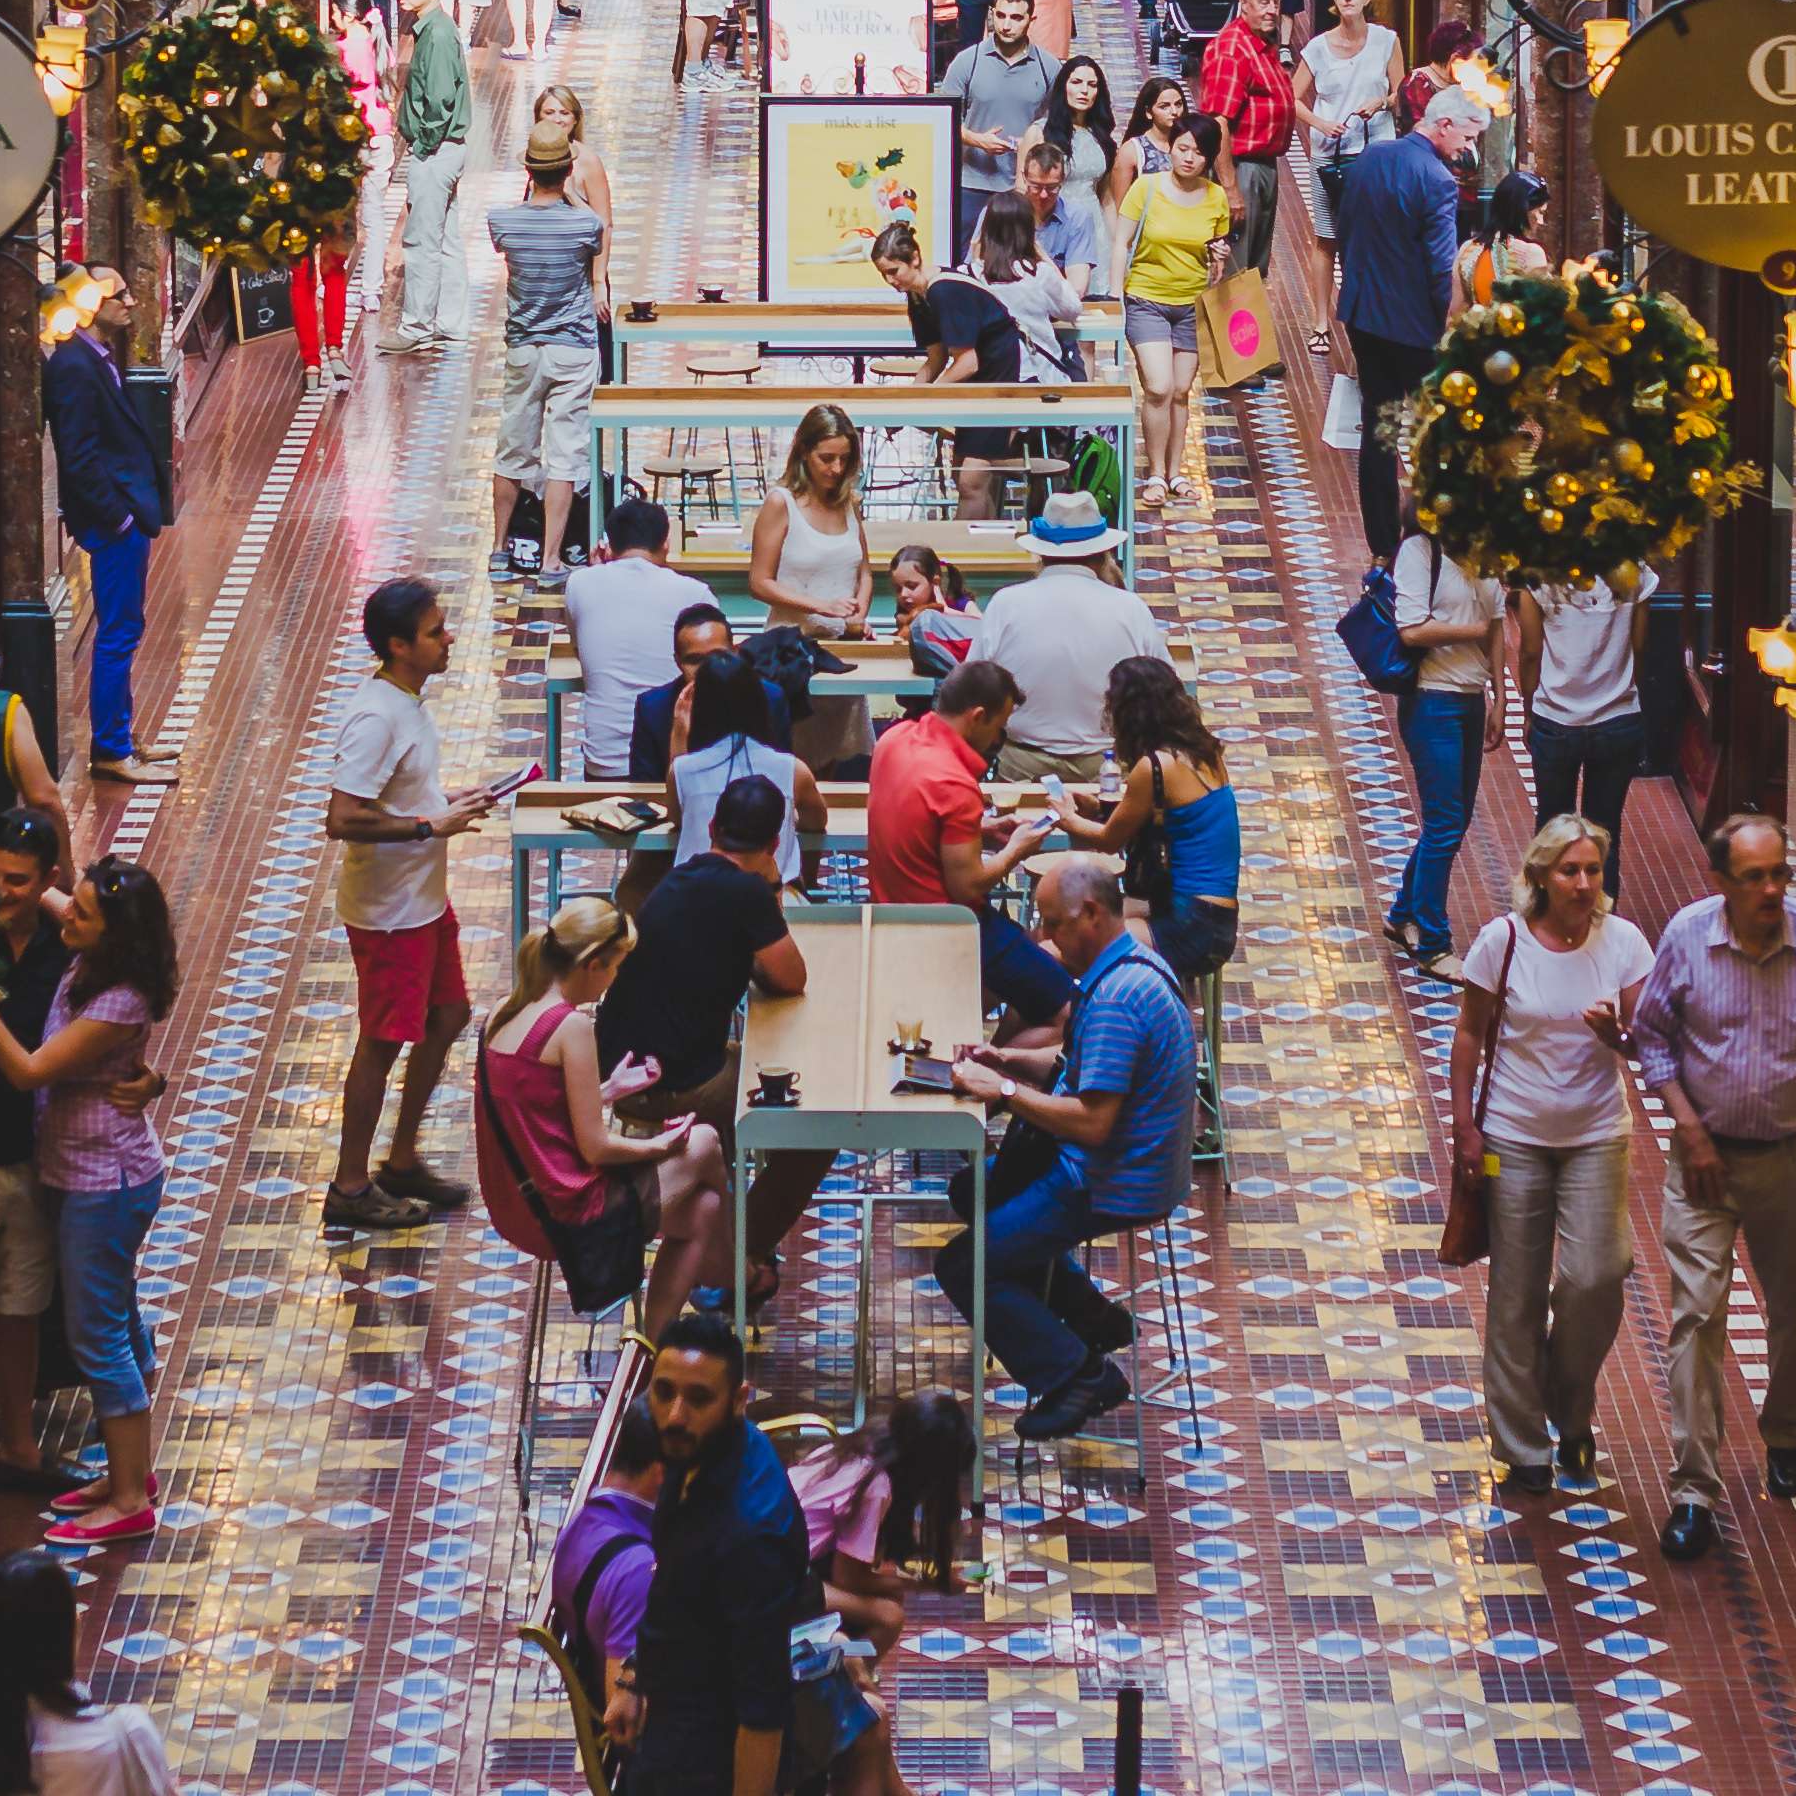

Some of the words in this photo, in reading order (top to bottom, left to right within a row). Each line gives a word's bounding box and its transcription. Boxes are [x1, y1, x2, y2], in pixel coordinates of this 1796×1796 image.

[823, 115, 861, 129] make
[864, 118, 873, 129] a
[876, 115, 898, 129] list
[1622, 122, 1755, 158] LOUIS
